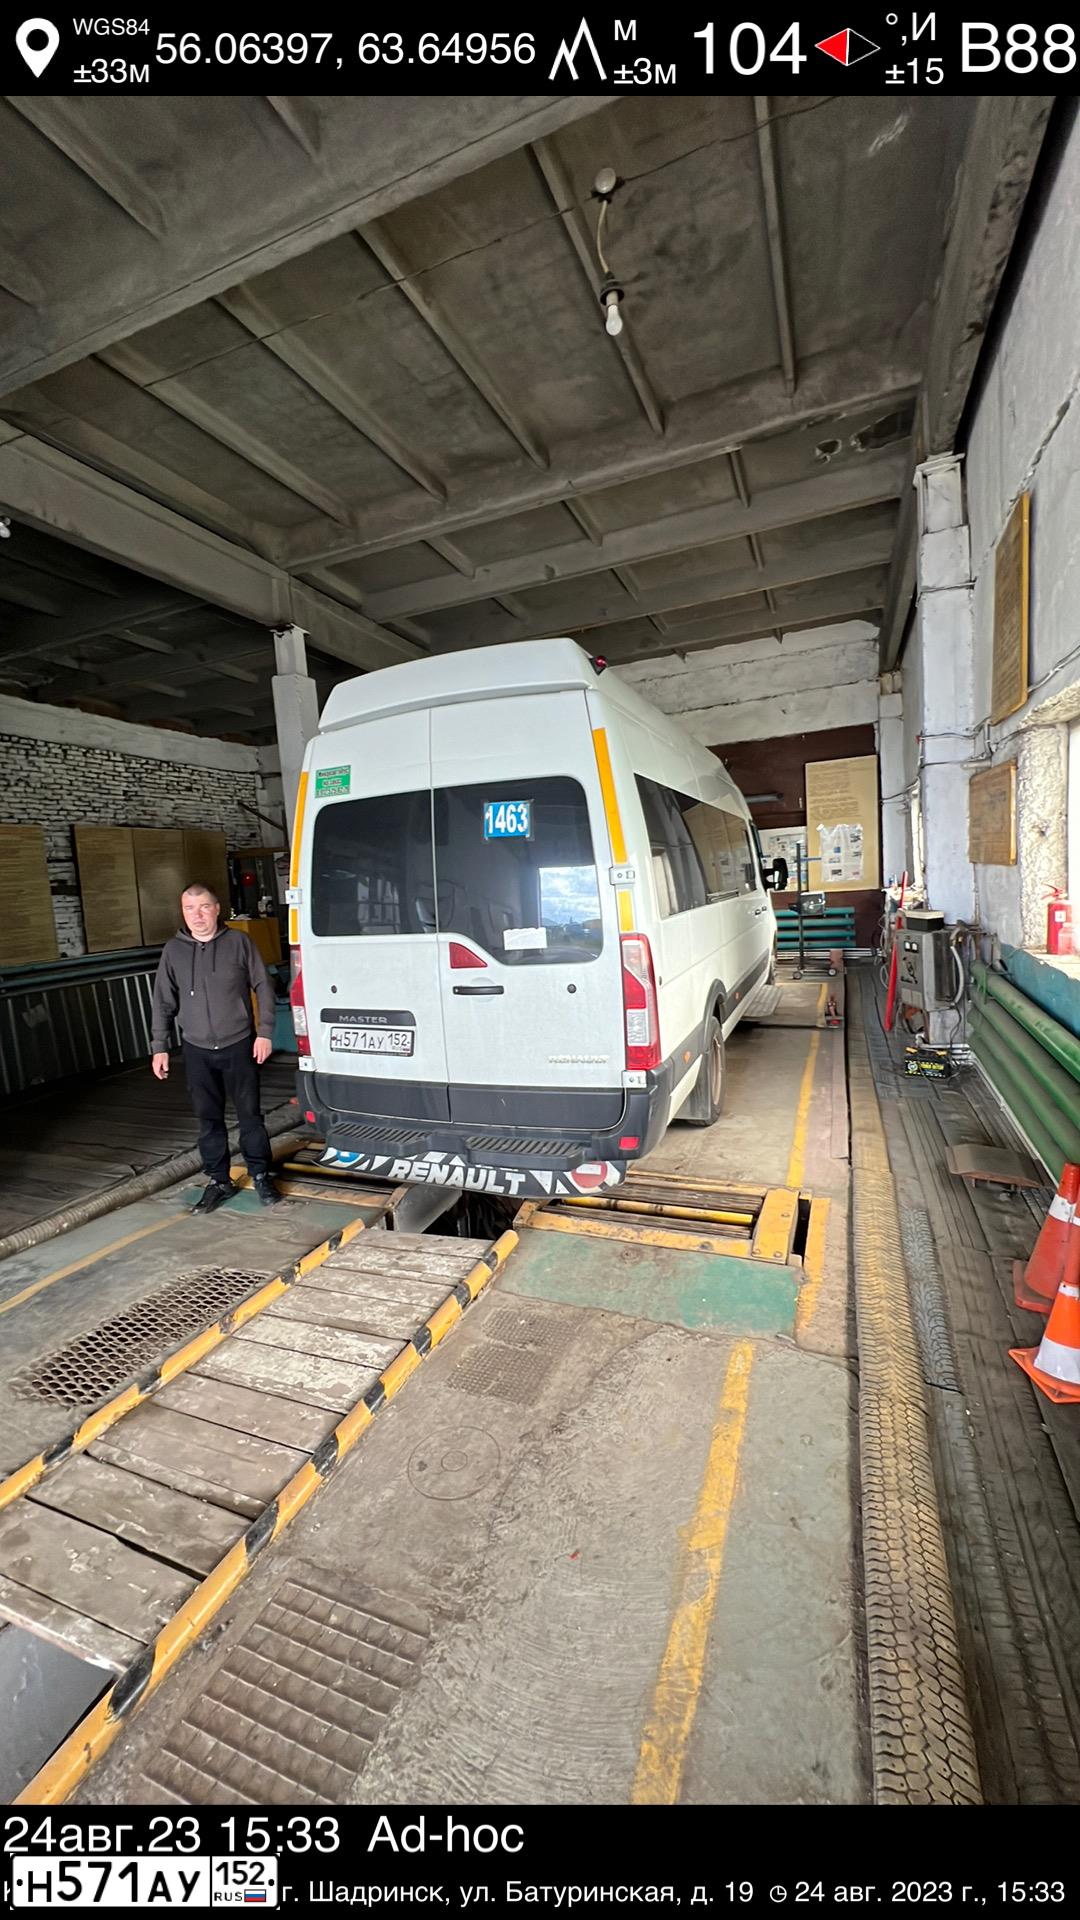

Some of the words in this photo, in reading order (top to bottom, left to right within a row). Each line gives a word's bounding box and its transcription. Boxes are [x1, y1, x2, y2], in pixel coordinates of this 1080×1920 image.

[485, 803, 529, 834] 1463
[339, 1015, 388, 1024] MASTER
[388, 1032, 408, 1047] 152
[387, 1158, 526, 1195] RENAULT
